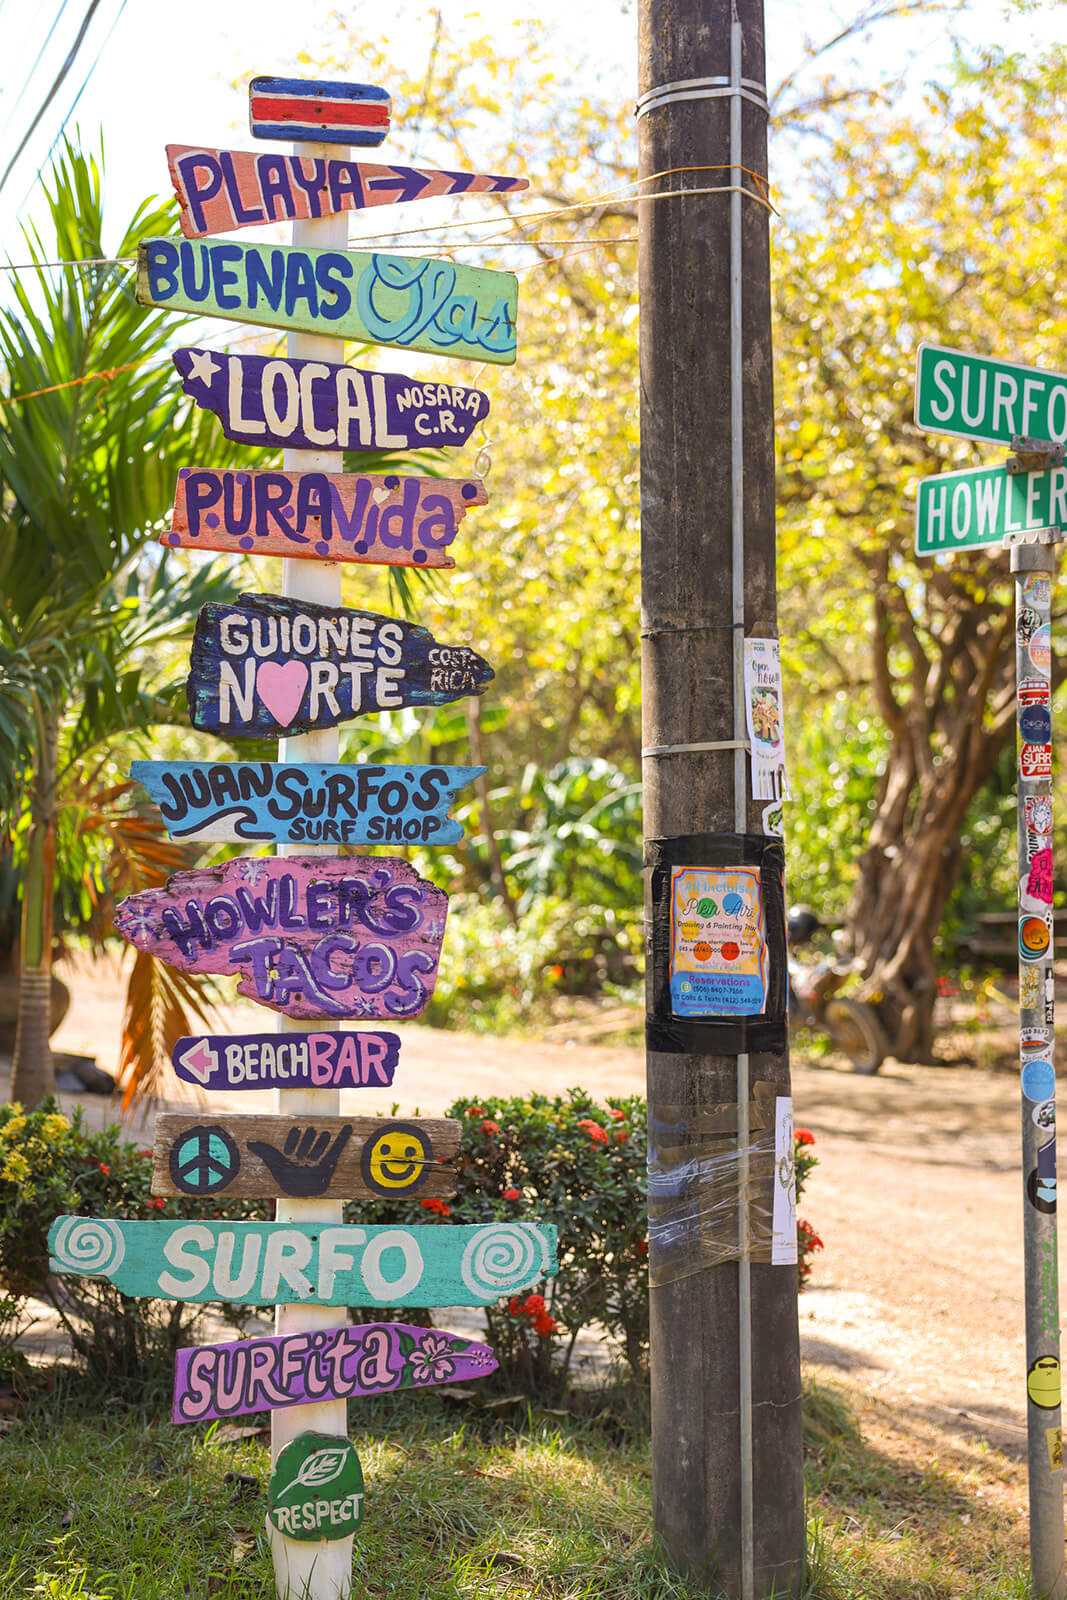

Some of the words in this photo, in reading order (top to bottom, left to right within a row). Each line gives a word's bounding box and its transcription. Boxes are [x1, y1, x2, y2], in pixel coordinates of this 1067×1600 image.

[177, 152, 364, 234] PLAYA
[146, 241, 353, 321] BUENAS
[357, 253, 518, 347] Olas
[228, 356, 409, 449] LOCAL
[396, 384, 481, 413] NOSARA
[415, 412, 465, 436] C.R.
[931, 360, 1067, 443] SURFO
[185, 472, 333, 543] PURA
[330, 477, 457, 552] Vida
[928, 466, 1067, 543] HOWLER
[220, 614, 404, 665] GUIONES
[431, 667, 476, 691] RICA
[161, 763, 274, 820] JUAN
[288, 817, 356, 841] SURF
[367, 817, 440, 841] SHOP
[162, 868, 427, 959] HOWLER'S
[229, 934, 437, 1018] TACOS
[689, 976, 750, 986] Reservations
[226, 1042, 309, 1082] BEACH
[307, 1033, 389, 1086] BAR
[157, 1224, 424, 1300] SURFO
[273, 1493, 364, 1533] RESPECT
